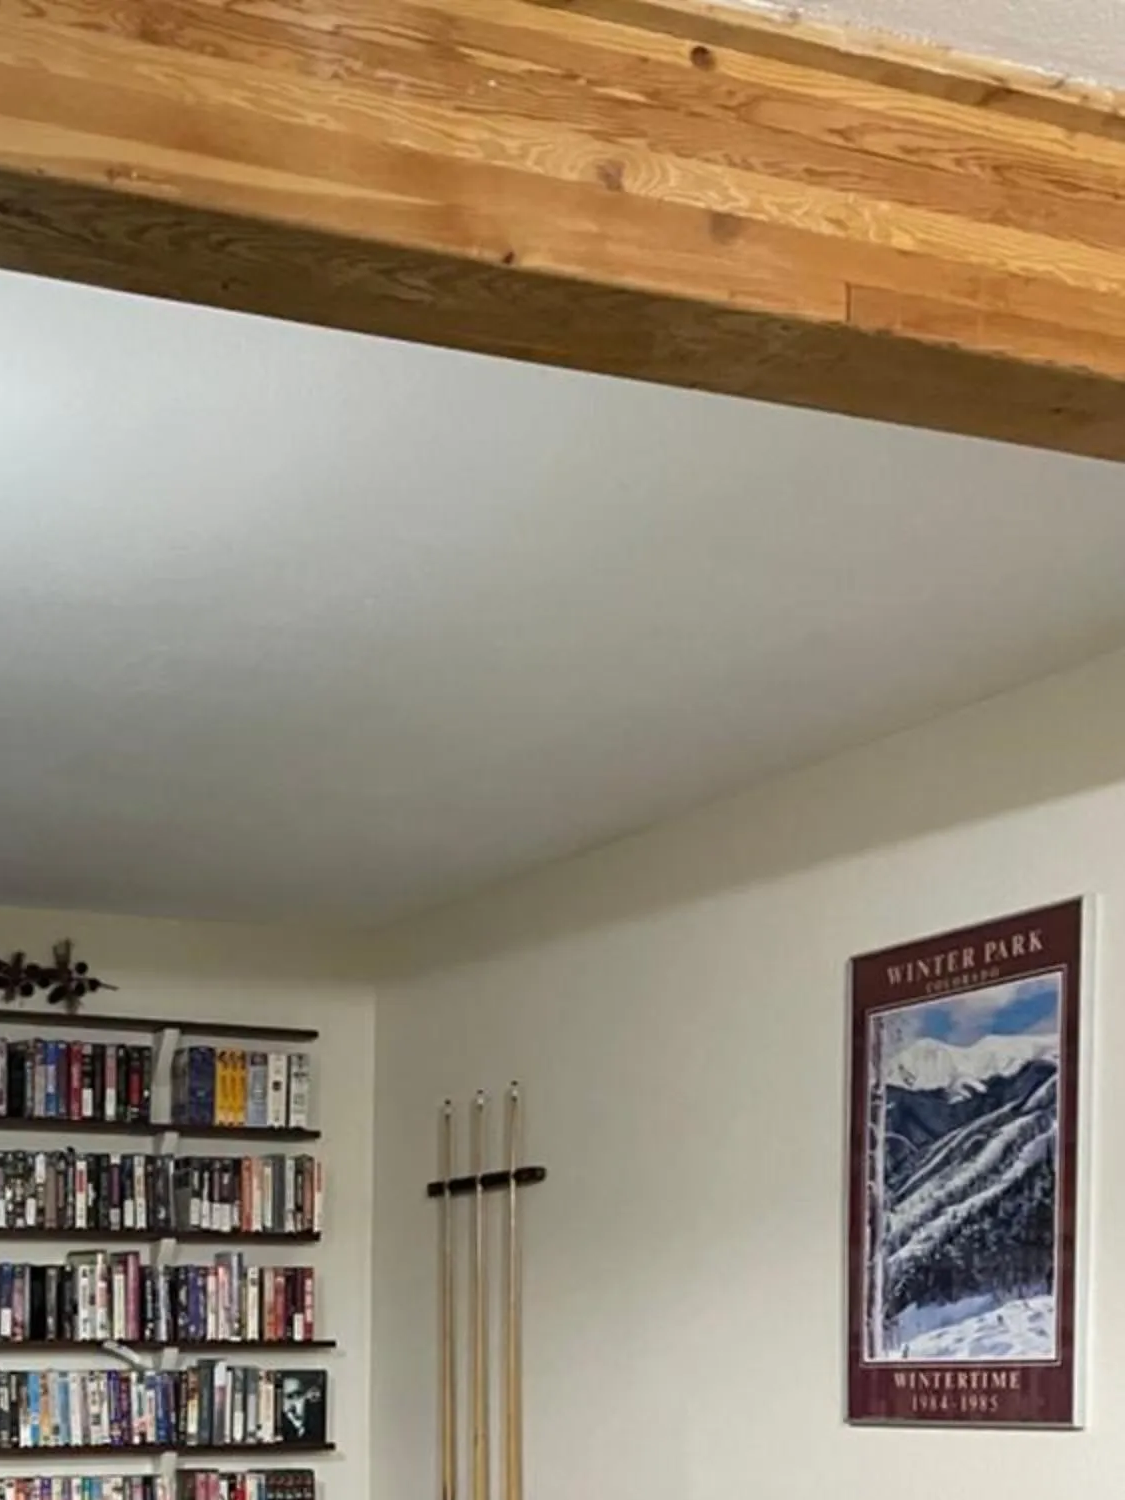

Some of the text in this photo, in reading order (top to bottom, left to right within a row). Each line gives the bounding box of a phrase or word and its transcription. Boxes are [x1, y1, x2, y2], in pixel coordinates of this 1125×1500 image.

[886, 929, 1044, 985] WINTER PARK
[893, 1371, 1021, 1389] WINTERTIME
